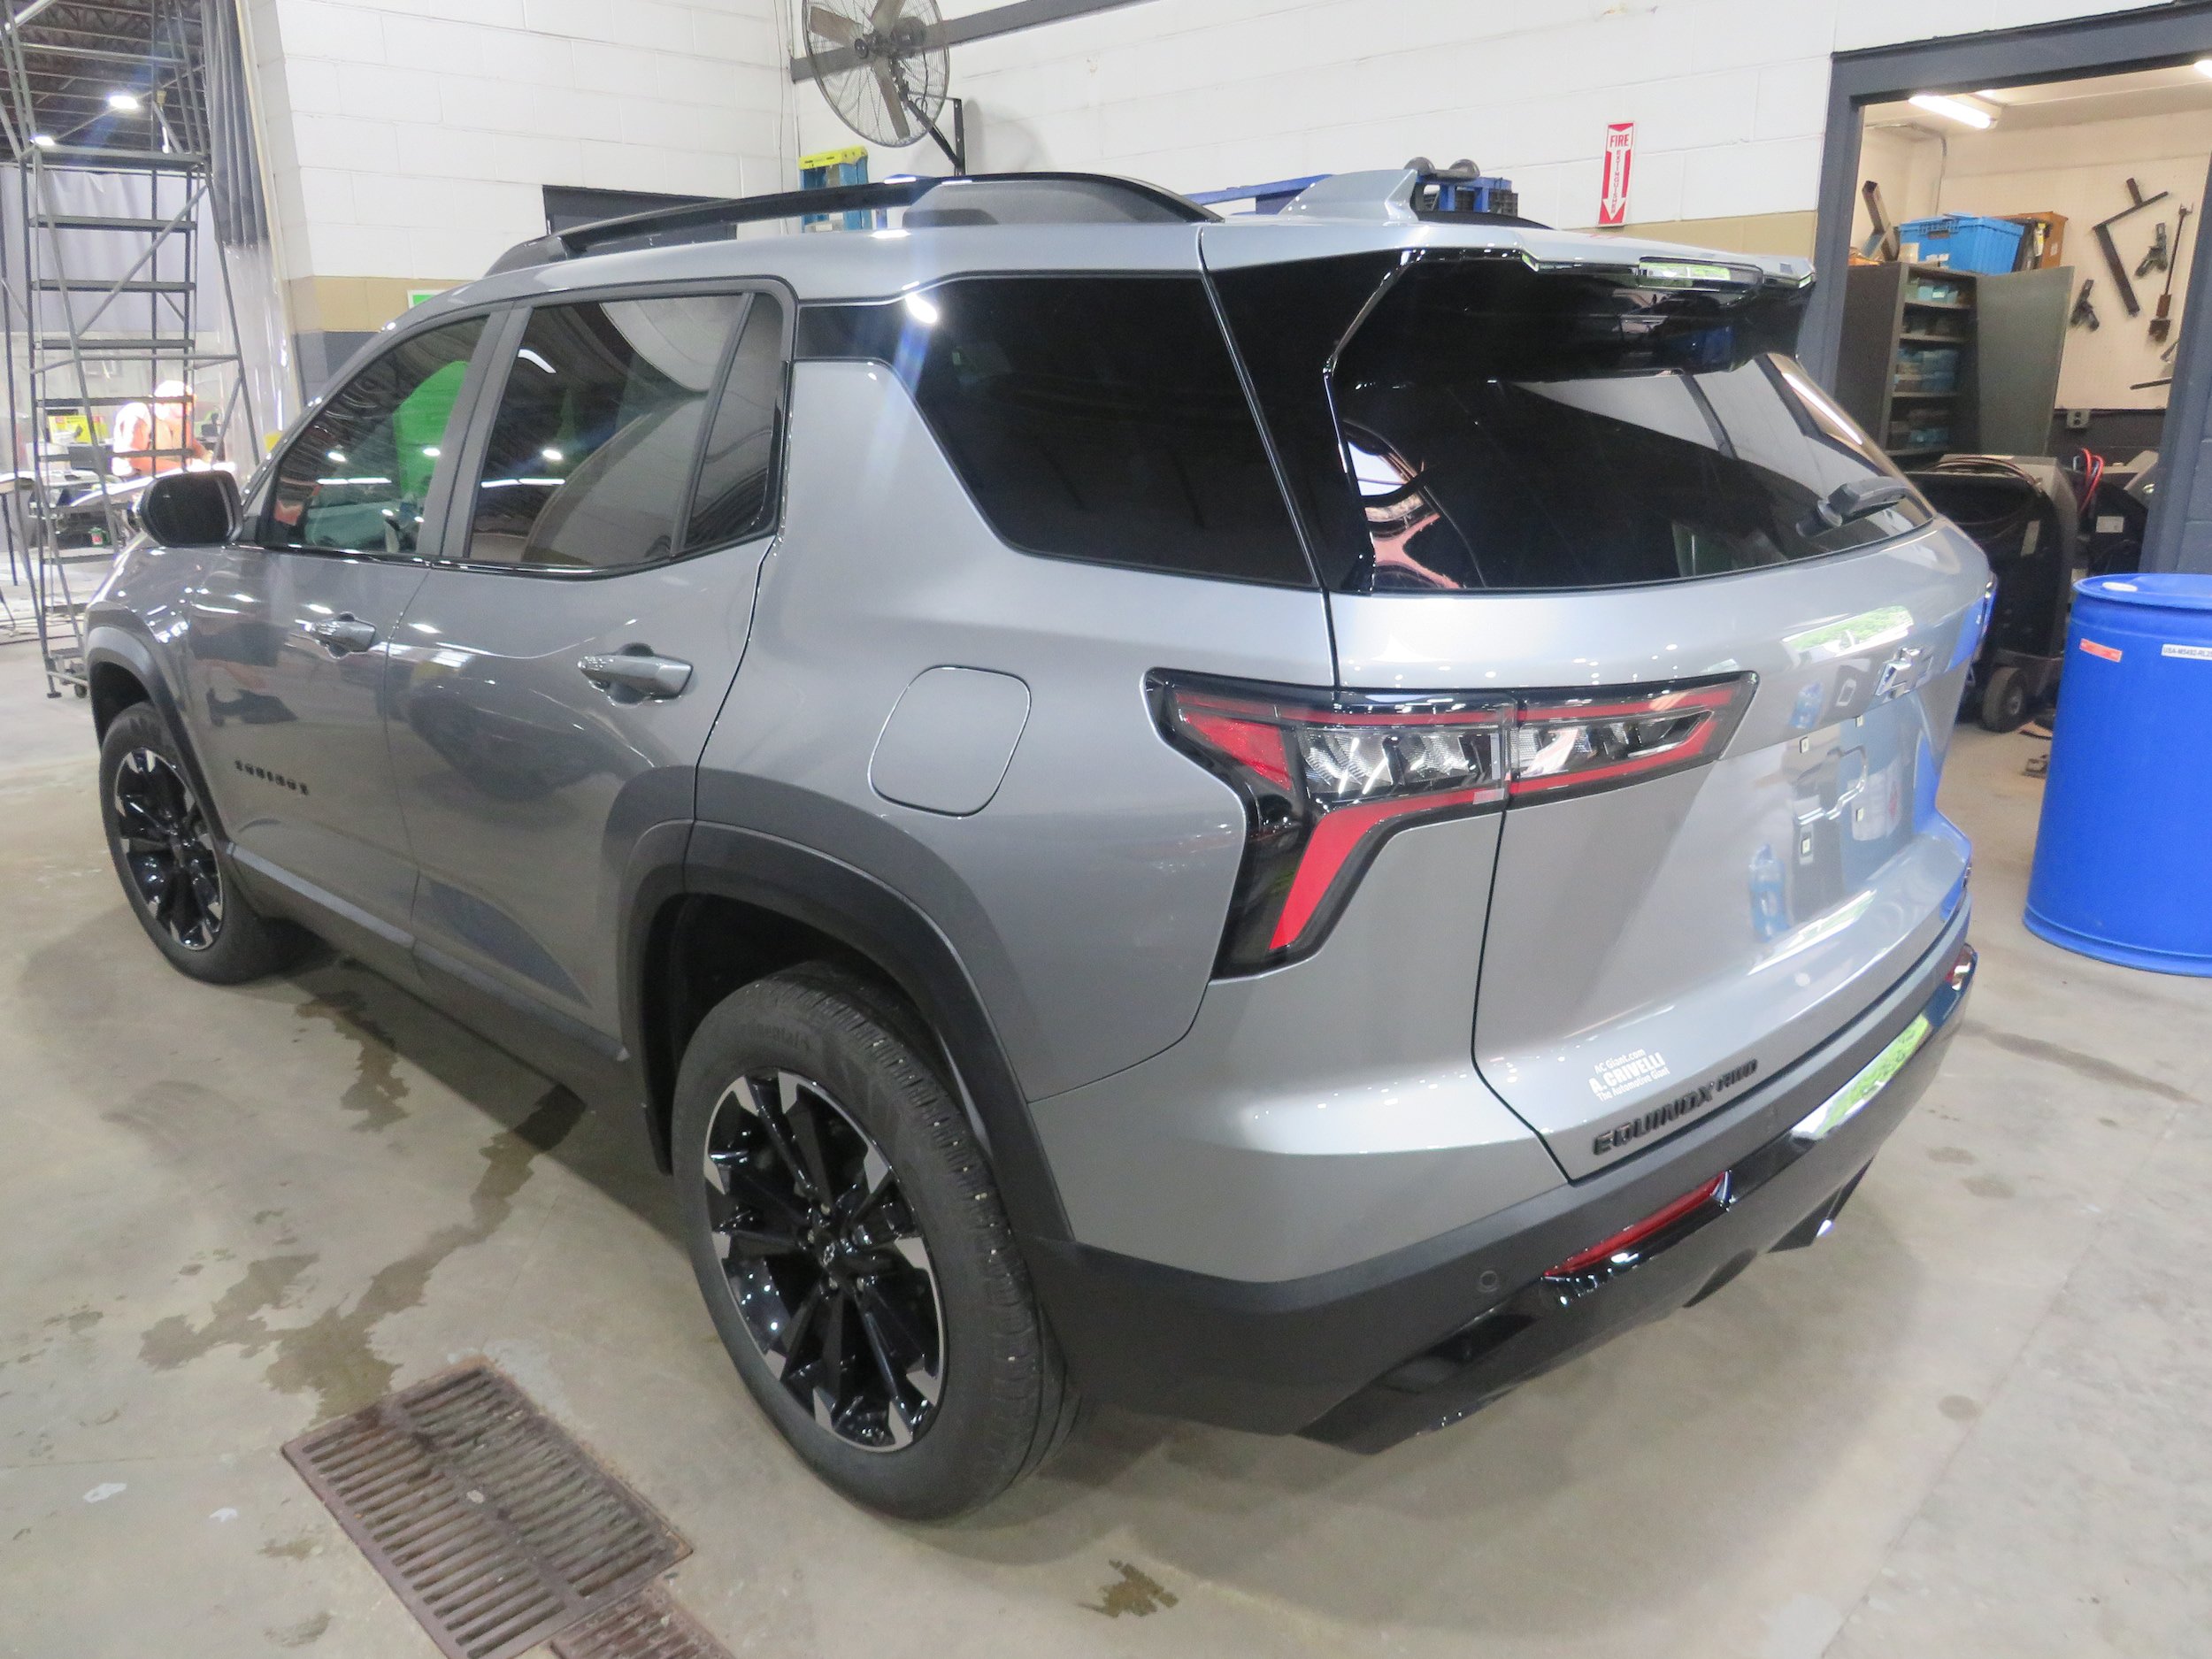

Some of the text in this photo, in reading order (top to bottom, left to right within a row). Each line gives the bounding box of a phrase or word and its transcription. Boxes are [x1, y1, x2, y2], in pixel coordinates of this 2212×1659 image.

[1610, 134, 1629, 147] FIRE
[1588, 1052, 1666, 1094] A. CRIVELLI
[1594, 1048, 1646, 1074] AC Giant.com
[1596, 1067, 1671, 1102] The Automotive Giant
[1593, 1086, 1712, 1155] EQUINOX
